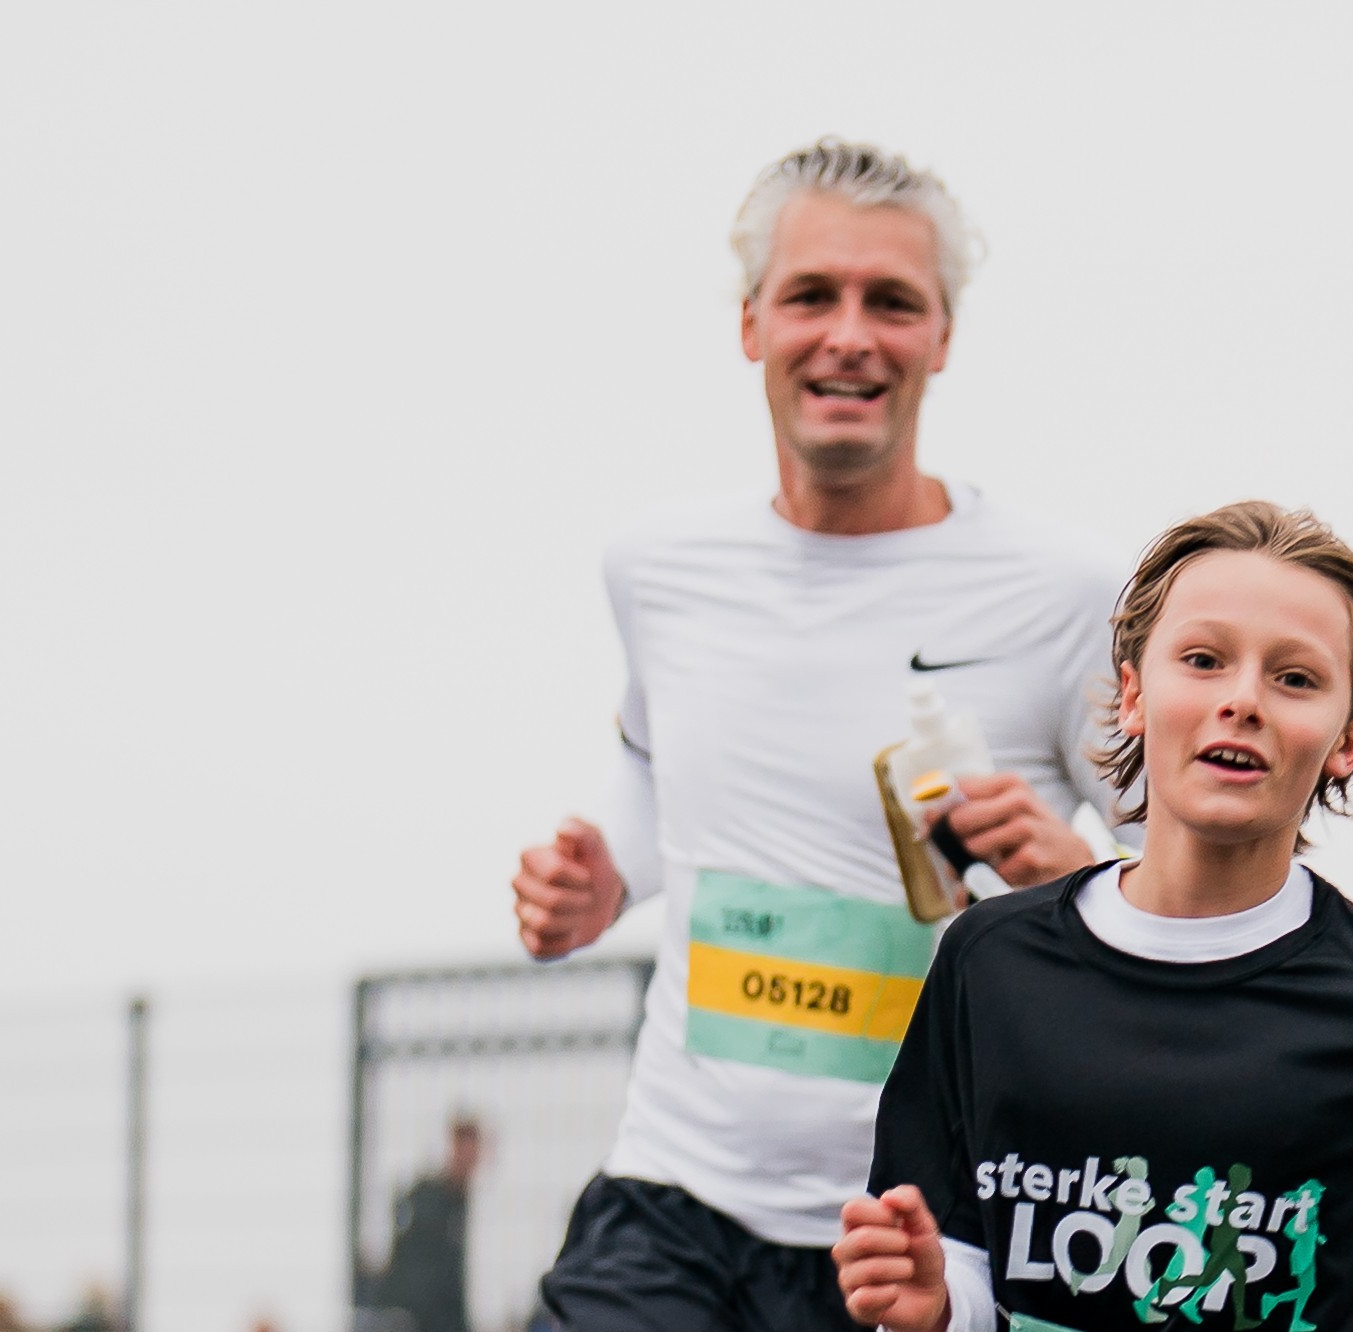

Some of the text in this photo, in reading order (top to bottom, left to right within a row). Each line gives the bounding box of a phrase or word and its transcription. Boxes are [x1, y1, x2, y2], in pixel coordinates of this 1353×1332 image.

[741, 971, 851, 1015] 05128
[977, 1152, 1315, 1232] sterke start
[1005, 1201, 1277, 1313] LOOP
